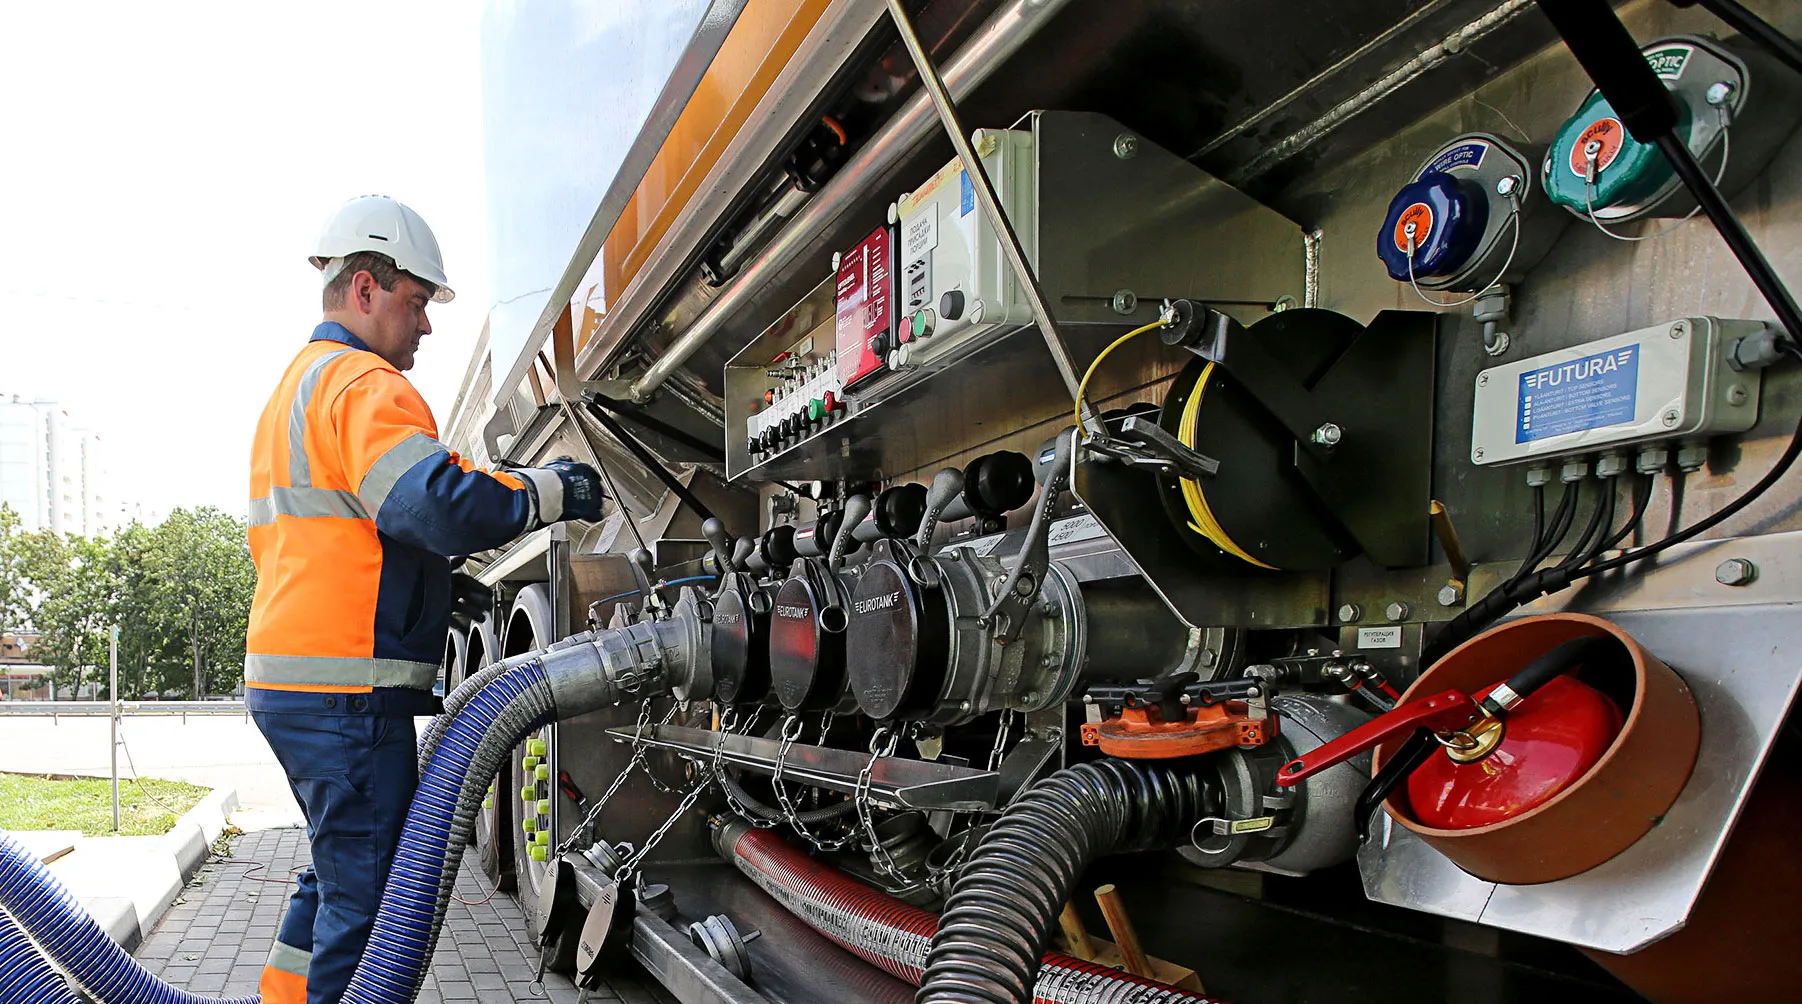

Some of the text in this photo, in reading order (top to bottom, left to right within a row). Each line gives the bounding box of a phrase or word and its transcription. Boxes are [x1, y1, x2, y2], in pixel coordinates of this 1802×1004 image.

[1435, 156, 1453, 171] WIRE
[1453, 150, 1474, 161] OPTIC
[1537, 355, 1618, 389] FUTURA
[1568, 389, 1591, 399] BOTTOM
[1591, 384, 1617, 394] SENSORS
[1564, 404, 1587, 414] BOTTOM
[1604, 395, 1631, 406] SENSORS
[1060, 518, 1085, 531] 5000
[780, 606, 805, 619] EUROTANK
[859, 594, 894, 613] EUROTANK
